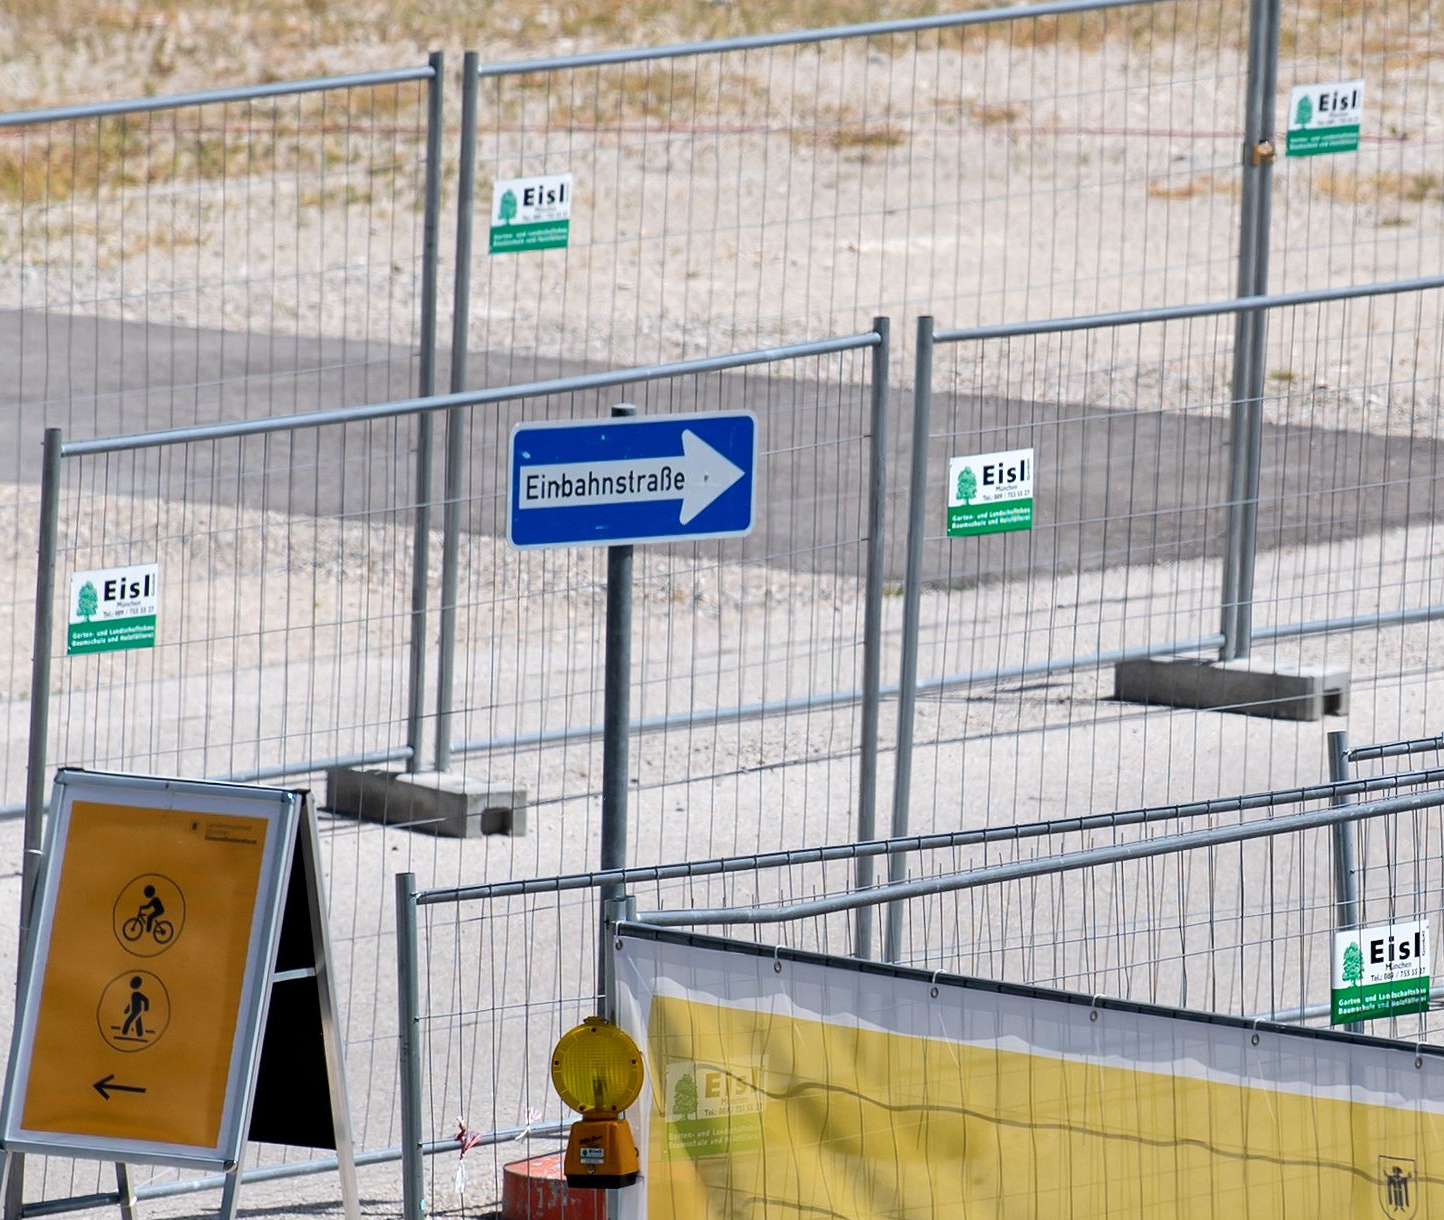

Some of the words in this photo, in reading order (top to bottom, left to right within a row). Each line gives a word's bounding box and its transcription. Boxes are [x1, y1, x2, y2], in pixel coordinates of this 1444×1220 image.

[1318, 91, 1357, 112] Eisl
[522, 184, 565, 207] Eisl
[526, 466, 685, 500] Einbahnstraße
[982, 461, 1025, 486] Eisl
[103, 575, 150, 602] Eisl
[97, 629, 108, 637] und
[1370, 933, 1421, 964] Eisl
